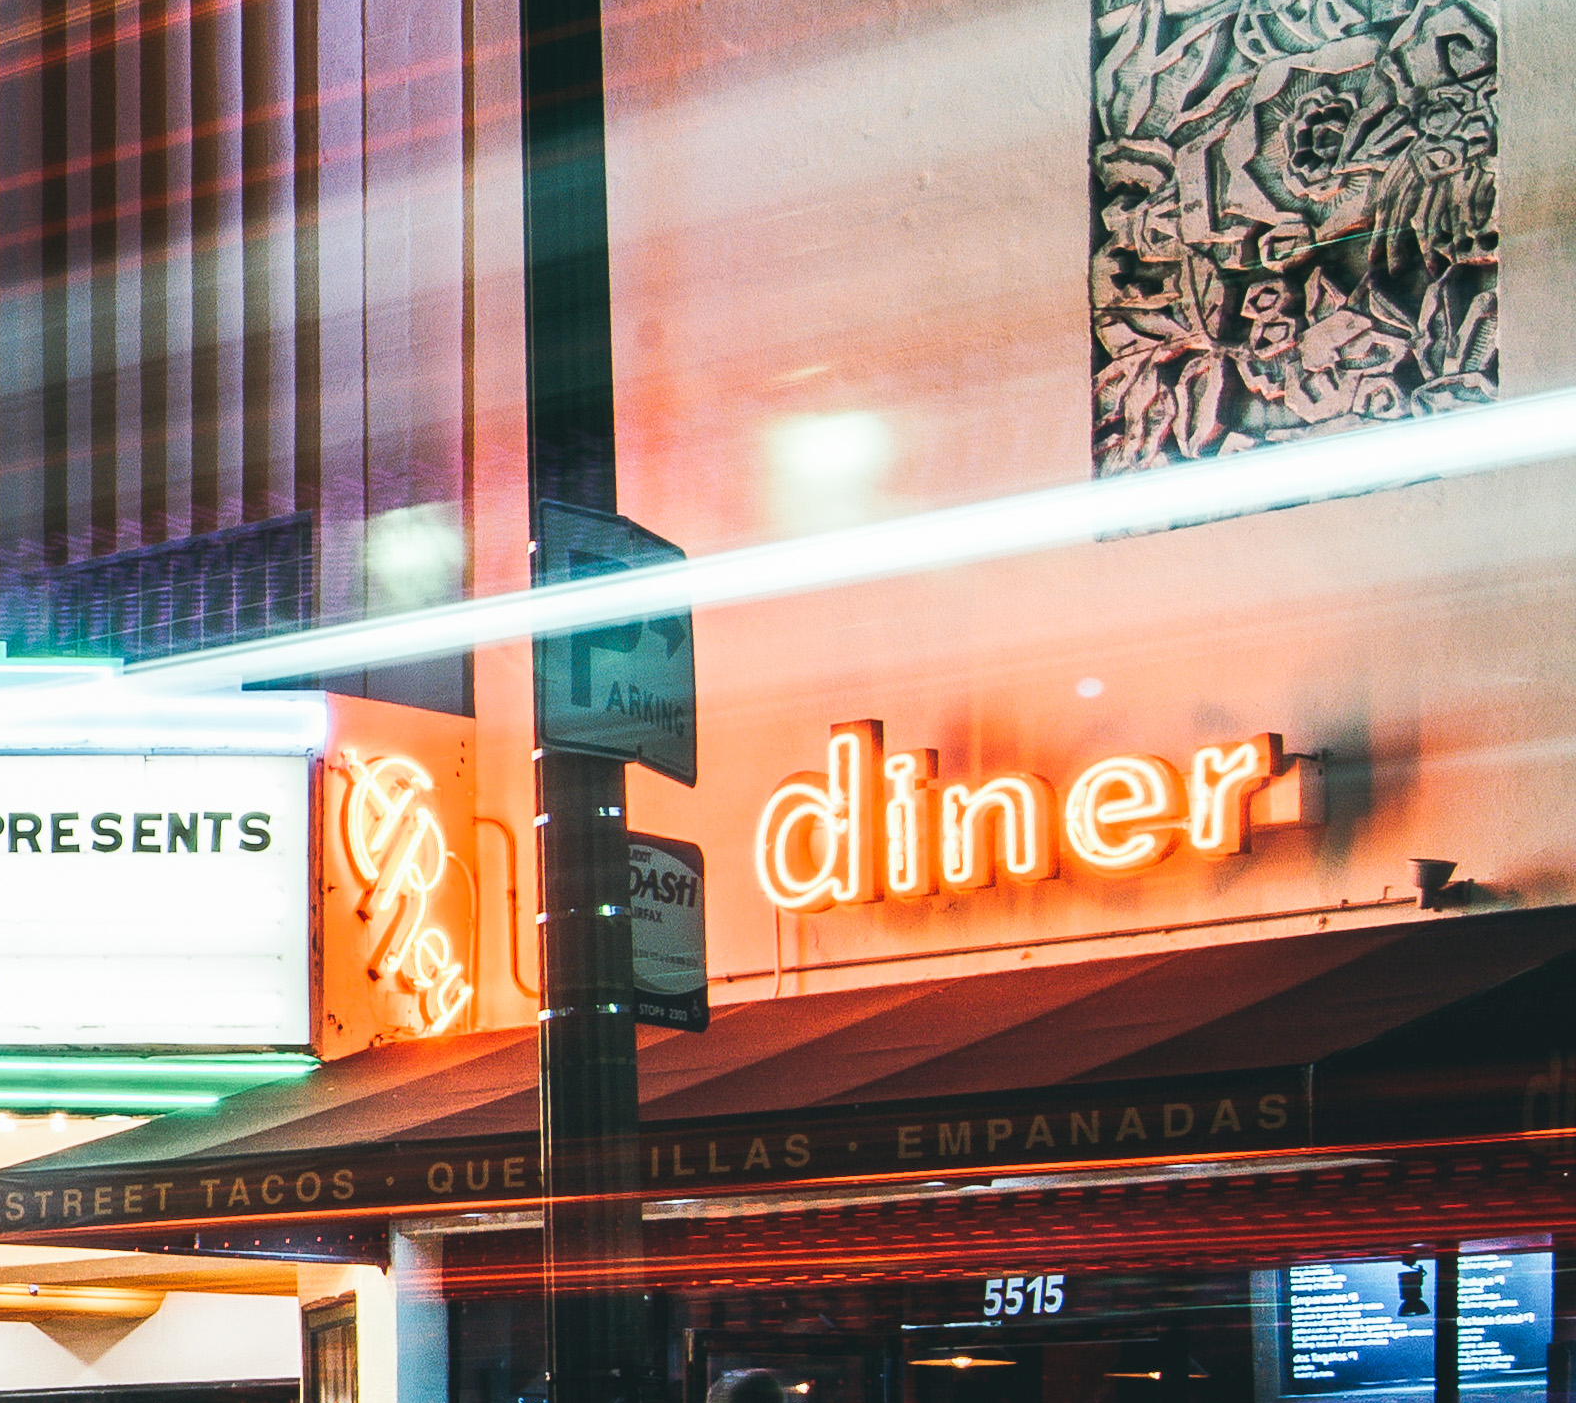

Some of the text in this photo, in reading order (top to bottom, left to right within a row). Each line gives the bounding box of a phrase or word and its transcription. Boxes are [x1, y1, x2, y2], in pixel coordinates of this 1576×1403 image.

[754, 717, 1283, 916] diner
[629, 865, 698, 909] DASH
[4, 1180, 189, 1223] STREET
[199, 1168, 356, 1210] TACOS
[895, 1092, 1290, 1160] EMPANADAS
[982, 1274, 1066, 1317] 5515
